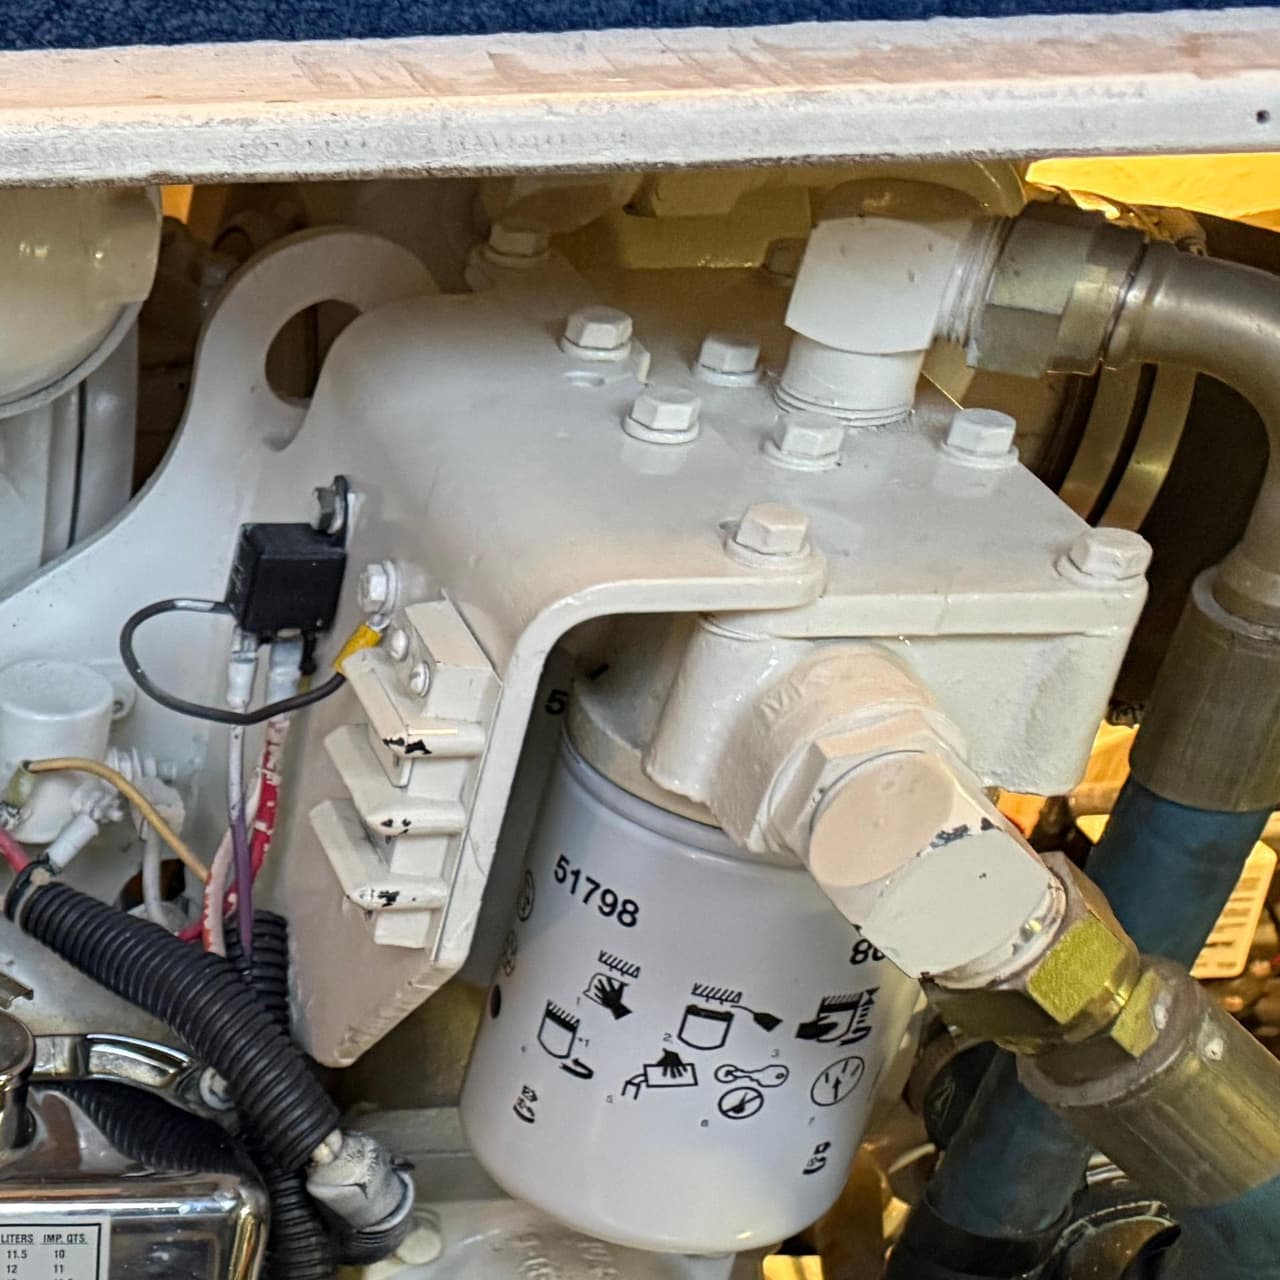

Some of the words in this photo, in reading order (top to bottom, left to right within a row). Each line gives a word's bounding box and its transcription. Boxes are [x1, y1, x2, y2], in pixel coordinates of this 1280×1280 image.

[553, 853, 639, 928] 51798
[0, 1232, 34, 1245] LITERS
[7, 1250, 28, 1260] 11.5
[54, 1250, 65, 1260] 10
[6, 1264, 18, 1274] 12
[53, 1264, 64, 1274] 11
